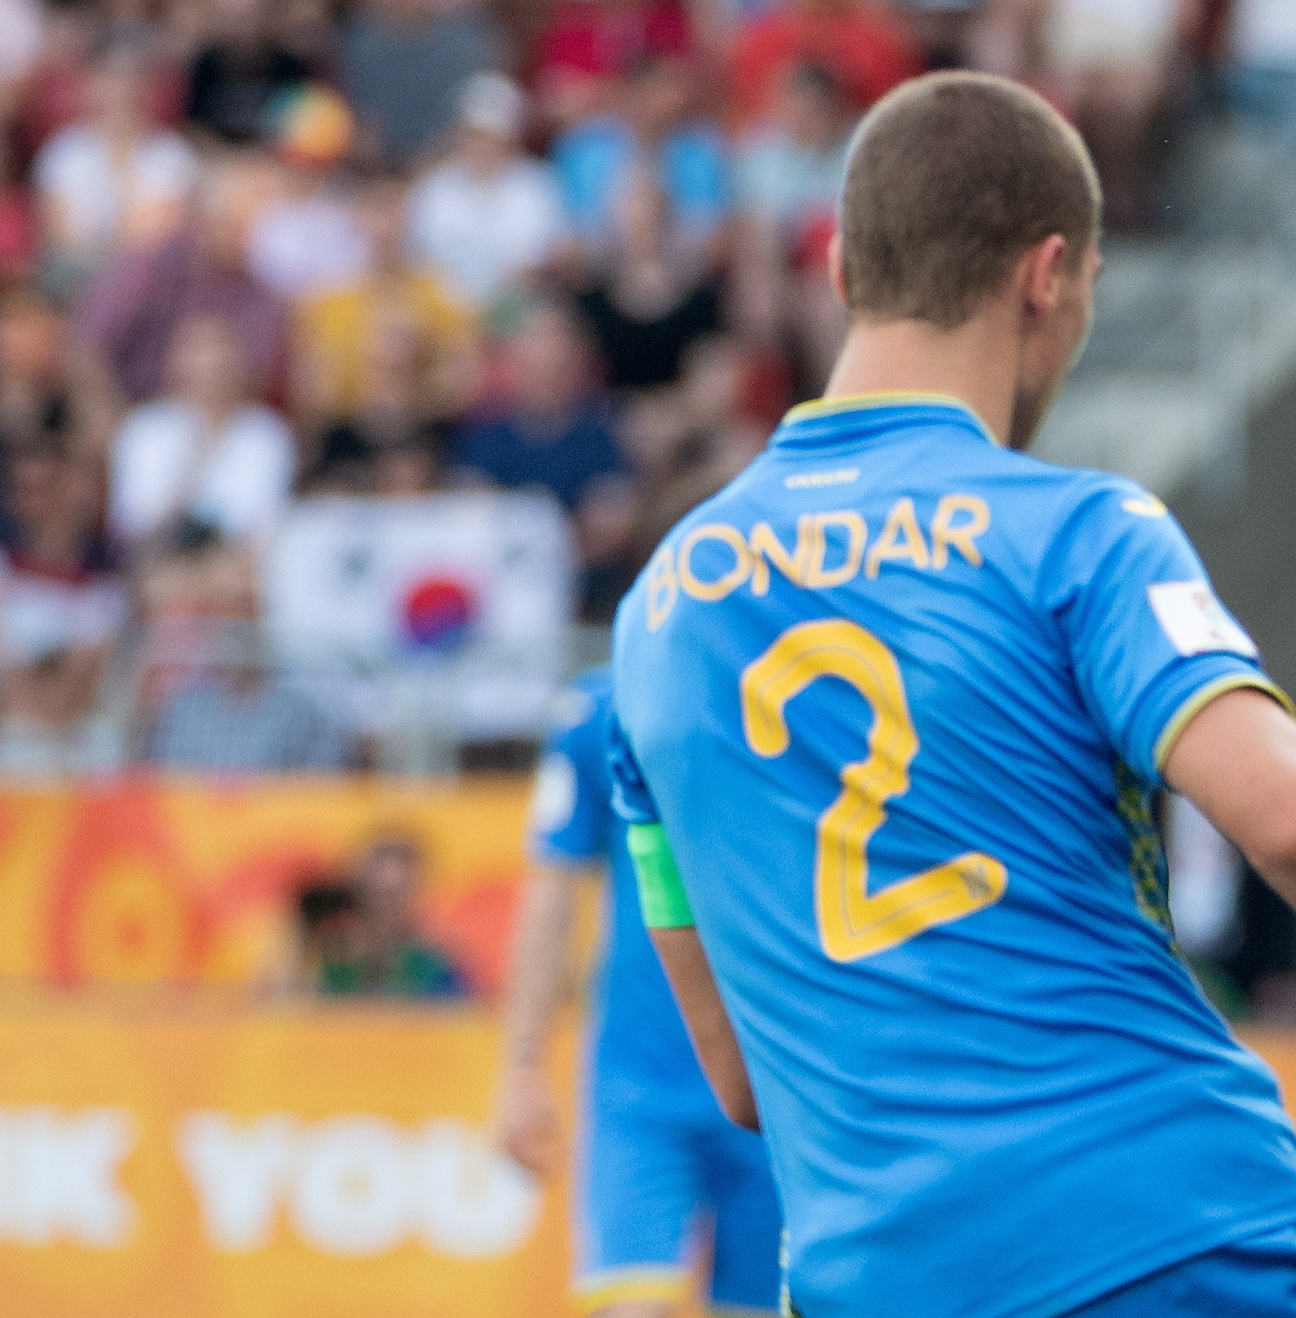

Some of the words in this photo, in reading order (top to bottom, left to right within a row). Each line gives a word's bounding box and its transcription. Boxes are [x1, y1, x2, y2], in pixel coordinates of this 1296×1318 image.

[645, 494, 990, 632] BONDAR
[740, 619, 1008, 963] 2
[176, 1112, 541, 1260] YOU
